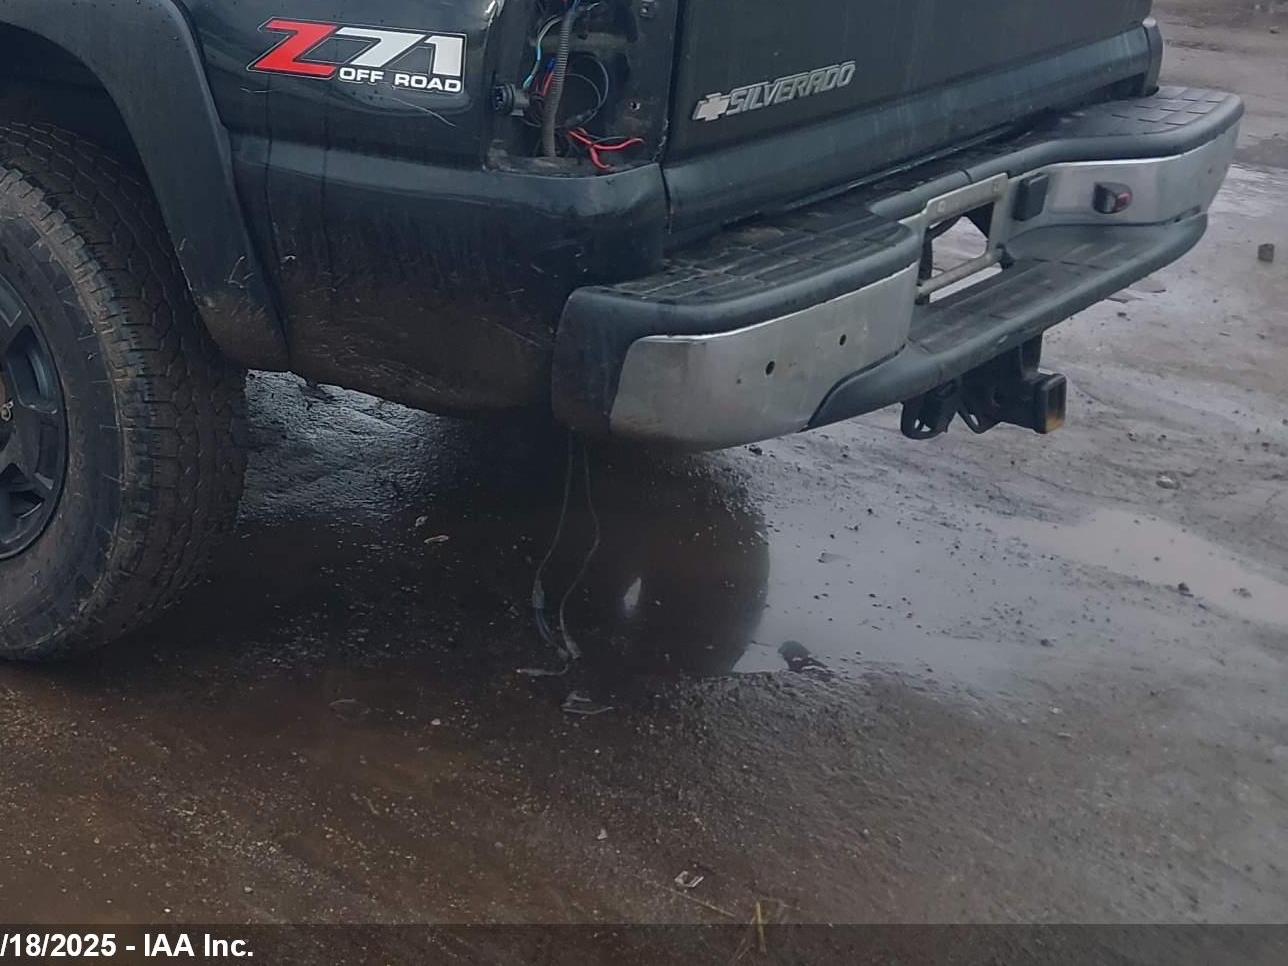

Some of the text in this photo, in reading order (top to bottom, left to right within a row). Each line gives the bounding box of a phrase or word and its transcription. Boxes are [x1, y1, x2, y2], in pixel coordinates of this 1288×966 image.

[253, 20, 463, 77] Z71
[338, 67, 462, 92] OFF ROAD
[725, 60, 857, 116] SILVERADO
